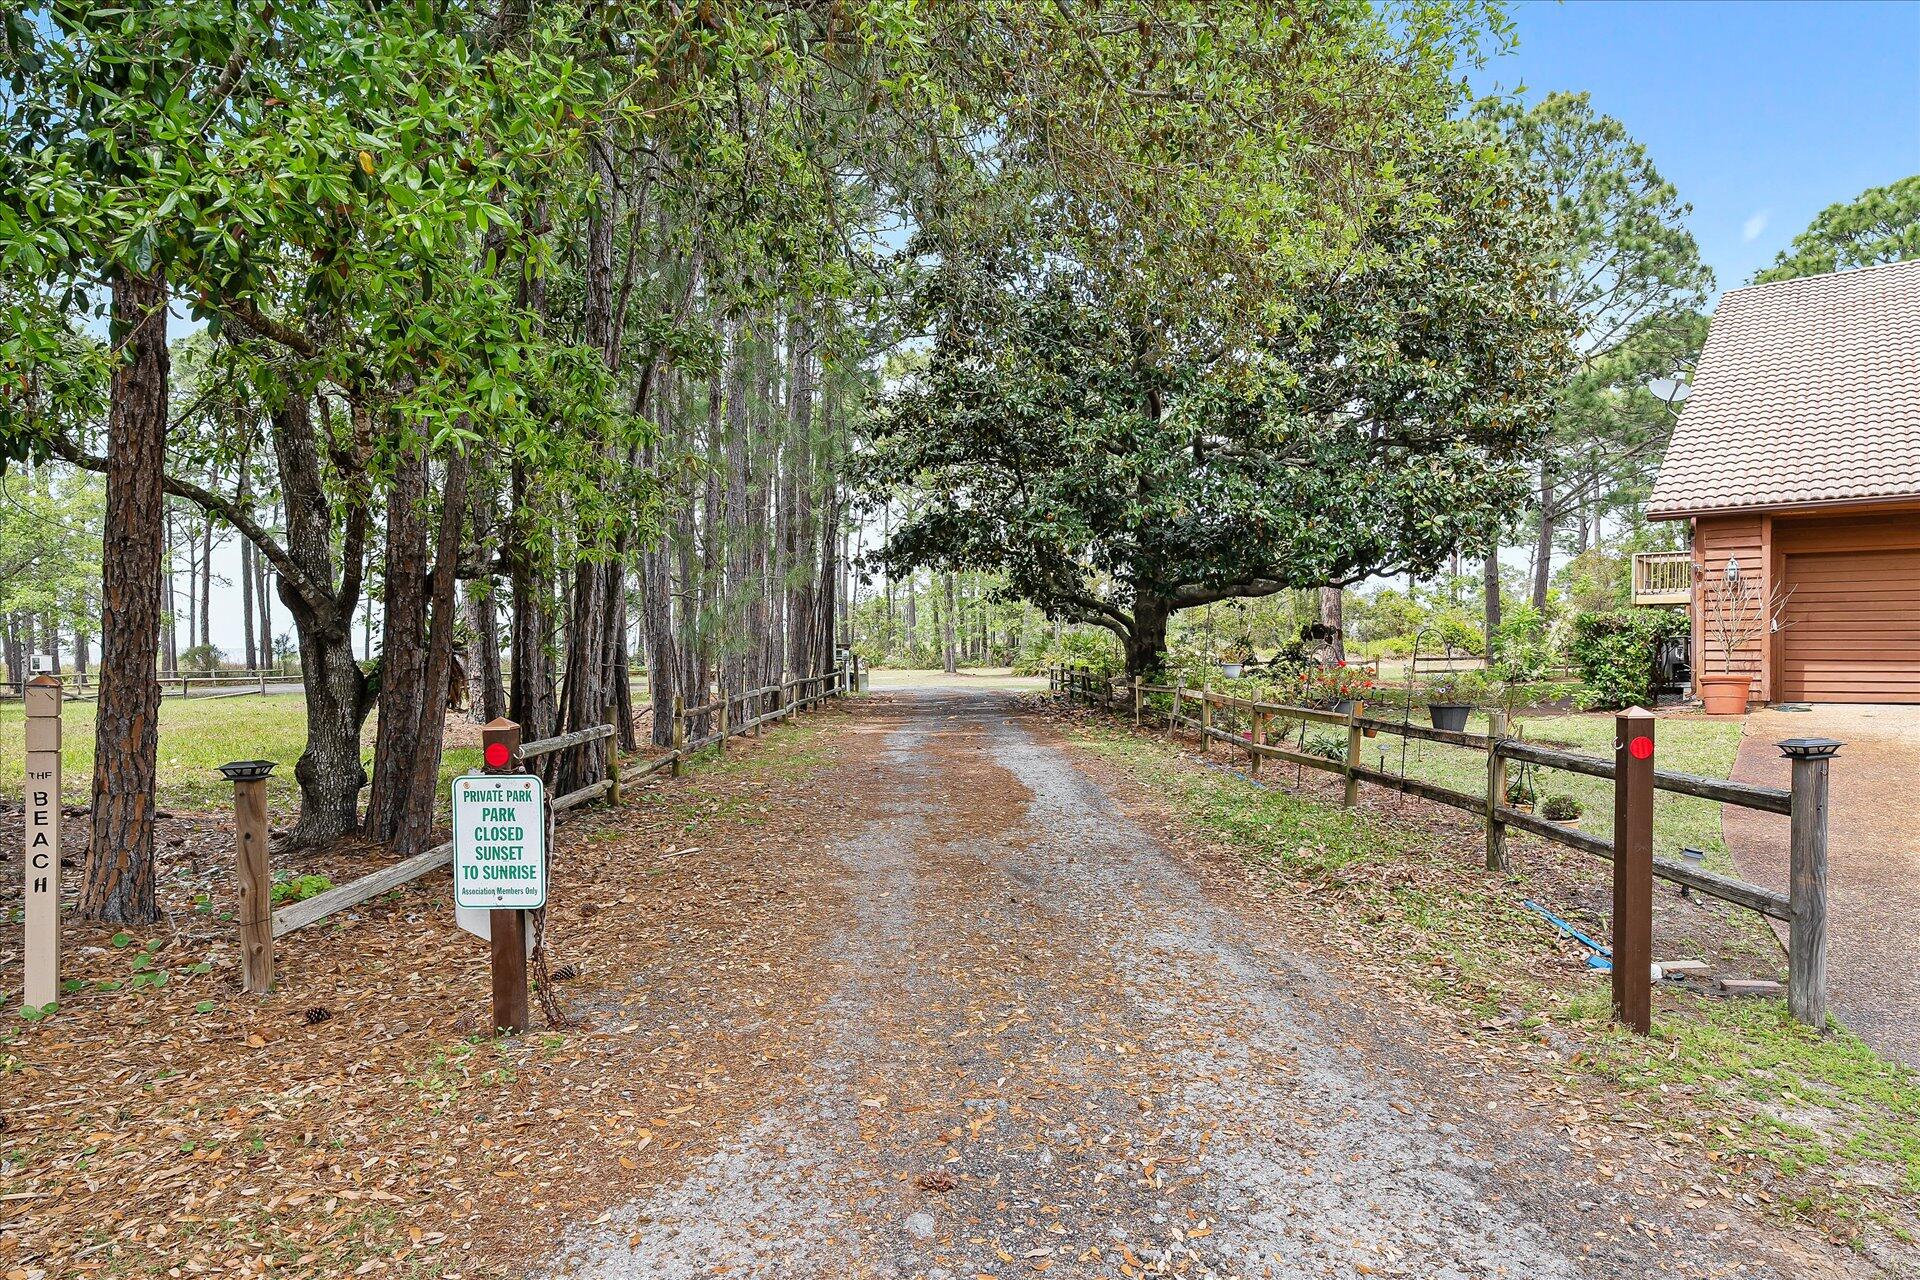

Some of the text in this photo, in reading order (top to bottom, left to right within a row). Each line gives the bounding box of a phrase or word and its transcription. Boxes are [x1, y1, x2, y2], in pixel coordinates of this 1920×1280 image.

[463, 790, 532, 802] PRIVATE PARK
[482, 807, 516, 822] PARK
[474, 826, 524, 841] CLOSED
[32, 791, 49, 893] BEACH
[475, 846, 524, 861] SUNSET
[462, 865, 537, 880] TO SUNRISE
[461, 886, 538, 896] Association Members Only
